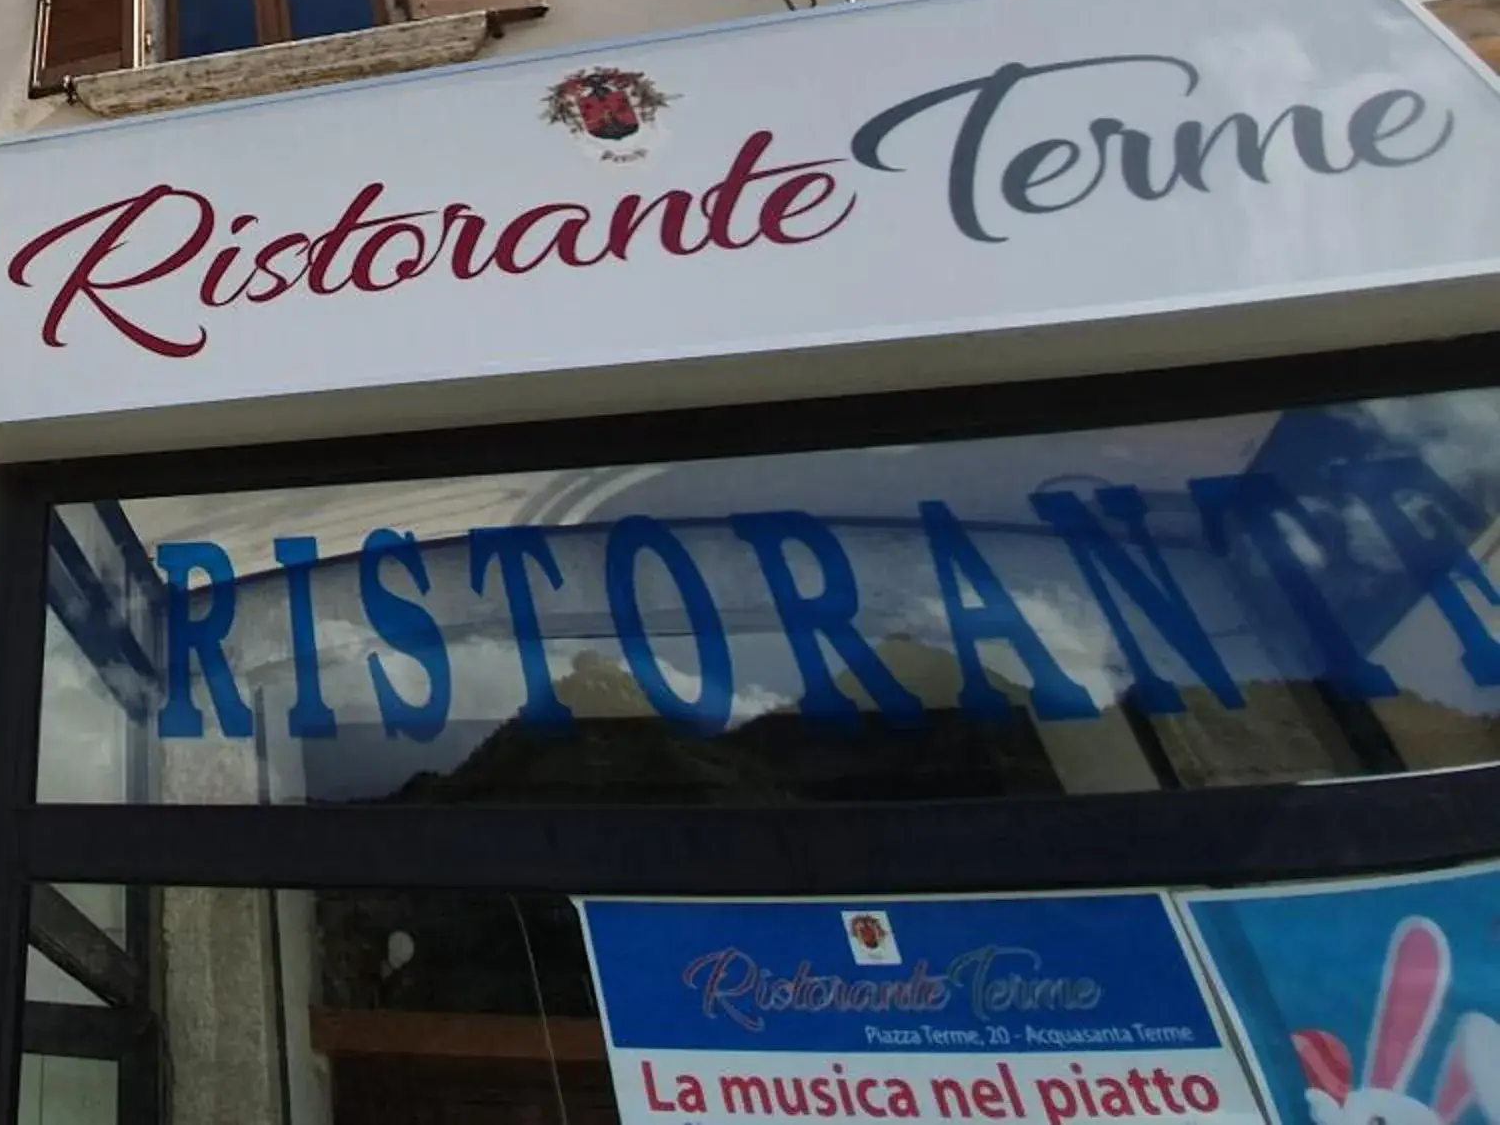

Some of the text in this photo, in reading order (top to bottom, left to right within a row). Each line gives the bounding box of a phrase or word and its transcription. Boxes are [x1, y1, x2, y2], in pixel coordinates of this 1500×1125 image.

[8, 53, 1455, 359] Ristorante Terme
[682, 944, 1103, 1032] Ristorante Terme
[864, 1024, 922, 1045] Piazza
[921, 1024, 985, 1047] Terme,
[986, 1025, 1010, 1045] 20
[1025, 1024, 1134, 1048] Acquasanta
[1131, 1022, 1195, 1044] Terme
[641, 1060, 1220, 1125] La musica nel piatto
